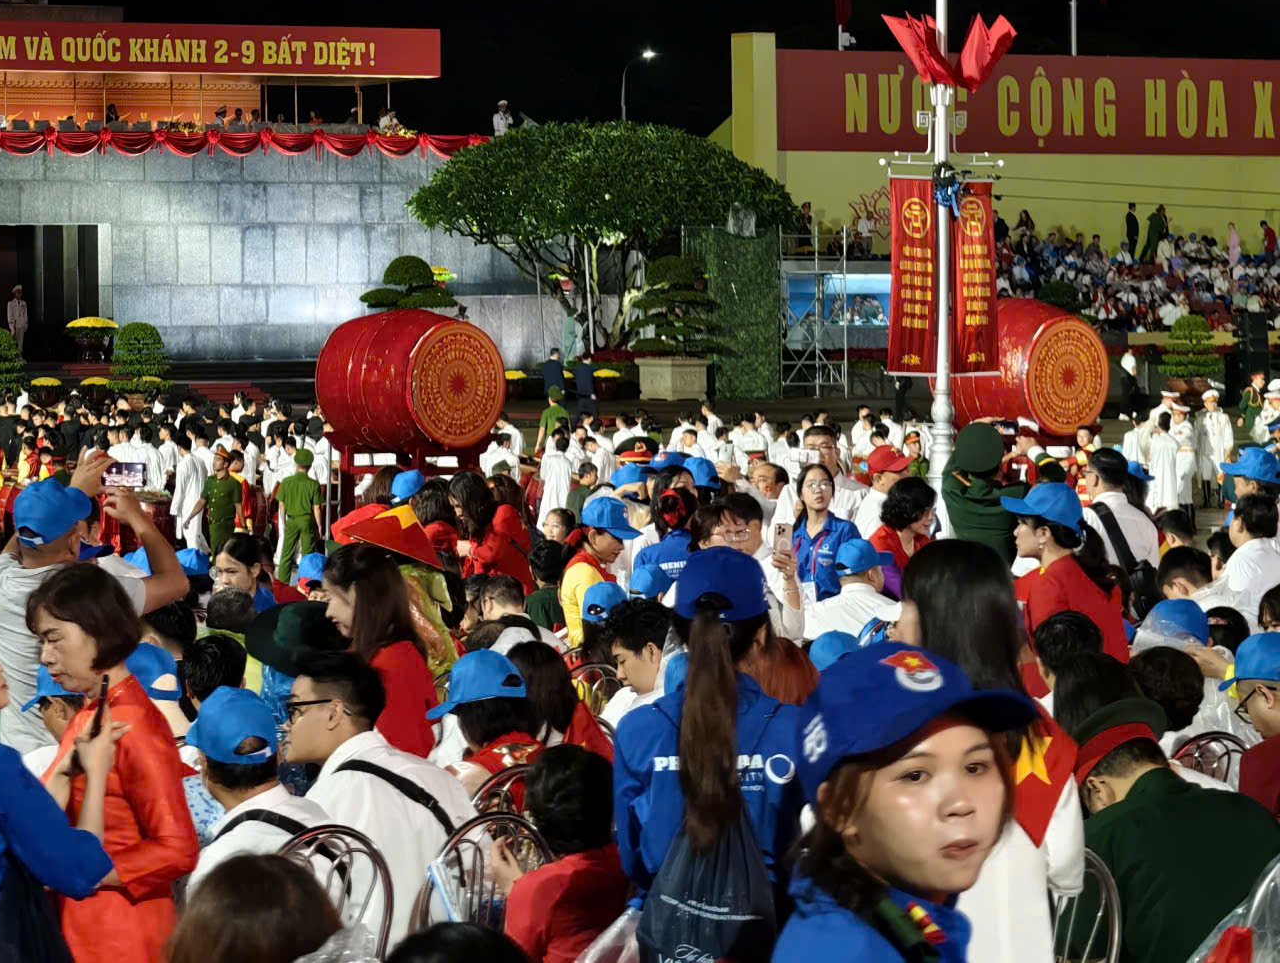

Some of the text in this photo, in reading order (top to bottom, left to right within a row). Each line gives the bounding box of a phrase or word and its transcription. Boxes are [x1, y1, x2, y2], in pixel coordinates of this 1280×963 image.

[23, 31, 55, 61] VÀ
[61, 30, 121, 63] QUỐC
[128, 33, 207, 64] KHÁNH
[214, 39, 256, 65] 2-9
[262, 33, 307, 66] BẤT
[997, 66, 1117, 148] CỘNG
[1144, 69, 1229, 139] HÒA
[1253, 80, 1276, 139] X
